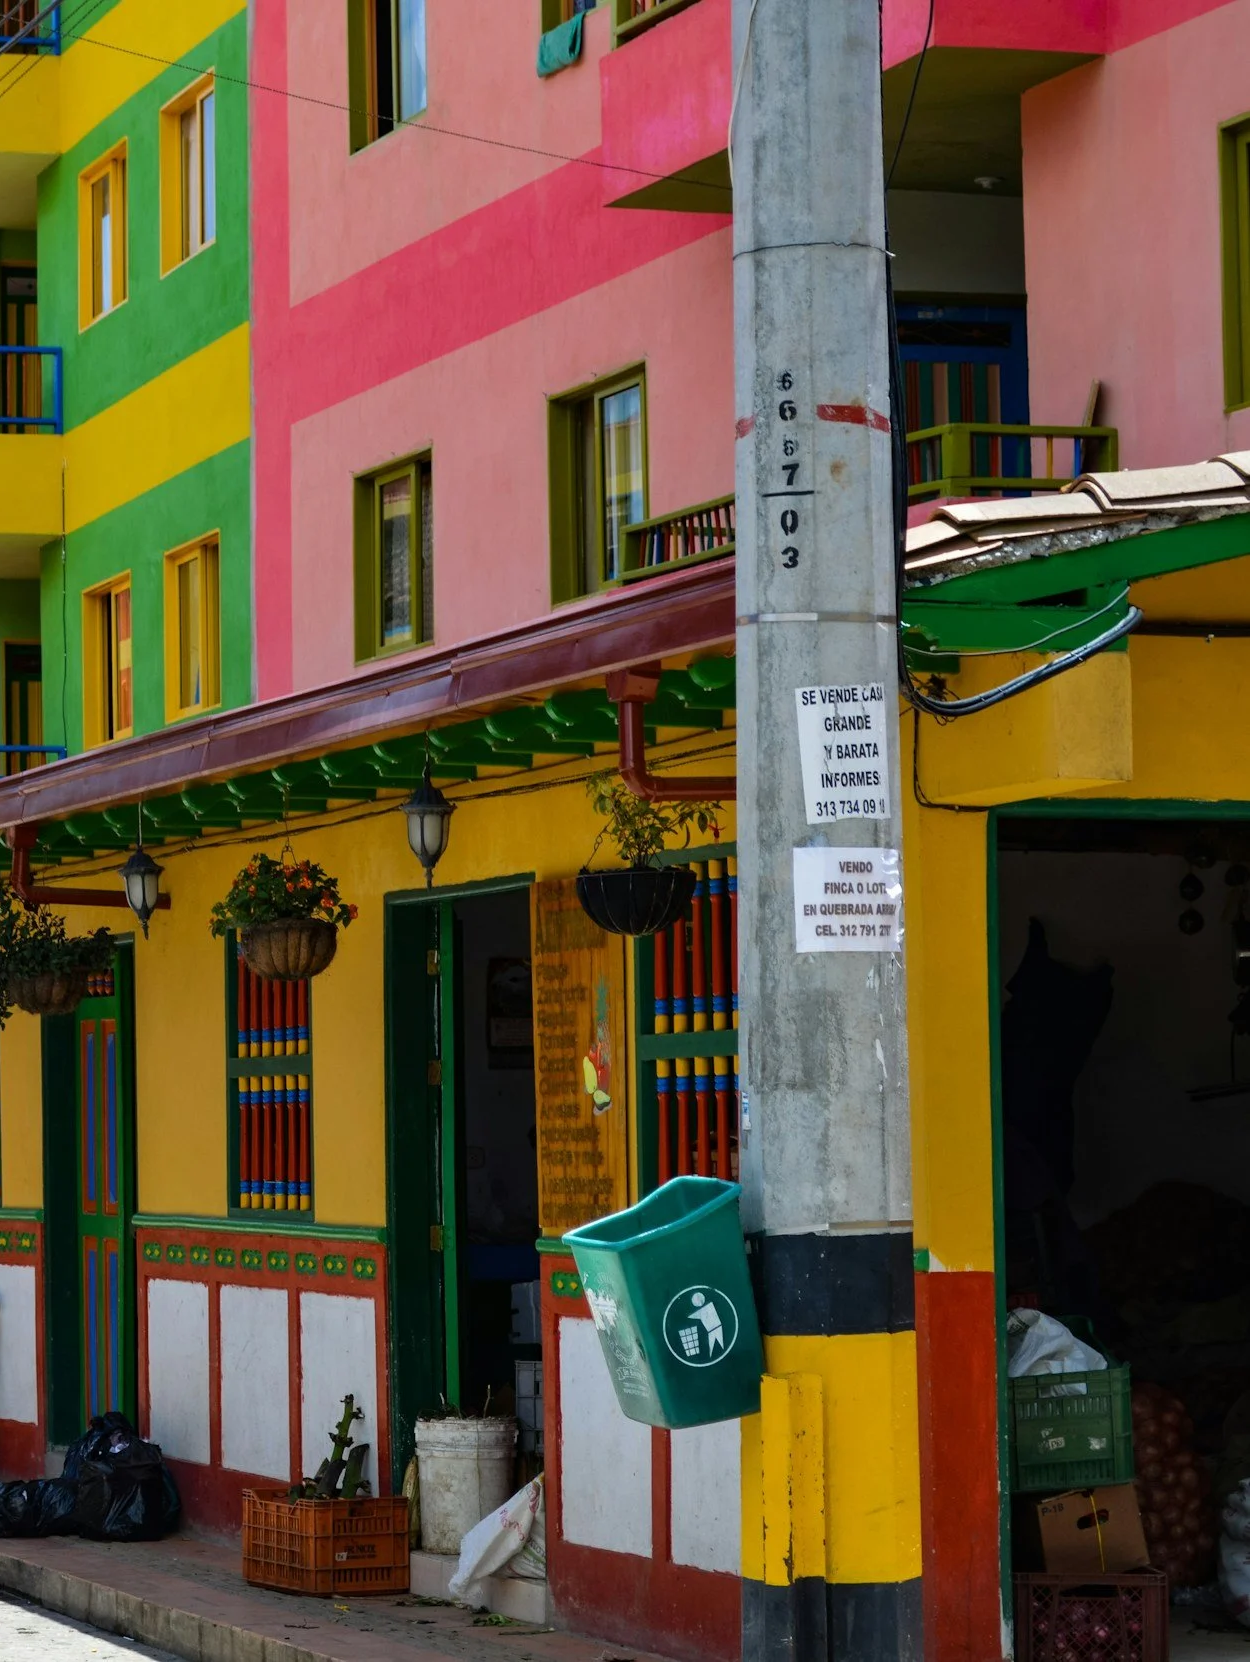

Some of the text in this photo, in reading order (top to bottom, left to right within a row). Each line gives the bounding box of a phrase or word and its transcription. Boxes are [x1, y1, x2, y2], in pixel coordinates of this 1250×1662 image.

[801, 690, 817, 706] SE
[819, 687, 859, 704] VENDE
[824, 714, 872, 732] GRANDE
[823, 742, 879, 760] Y BARATA
[820, 770, 881, 789] INFORMES
[816, 801, 837, 817] 313
[839, 800, 860, 815] 734
[862, 798, 876, 814] 09
[838, 861, 873, 874] VENDO
[824, 882, 854, 895] FINCA
[856, 882, 864, 895] O
[803, 904, 817, 917] EN
[819, 903, 873, 916] QUEBRADA
[815, 924, 838, 937] CEL.
[839, 924, 857, 937] 312
[859, 924, 876, 937] 791
